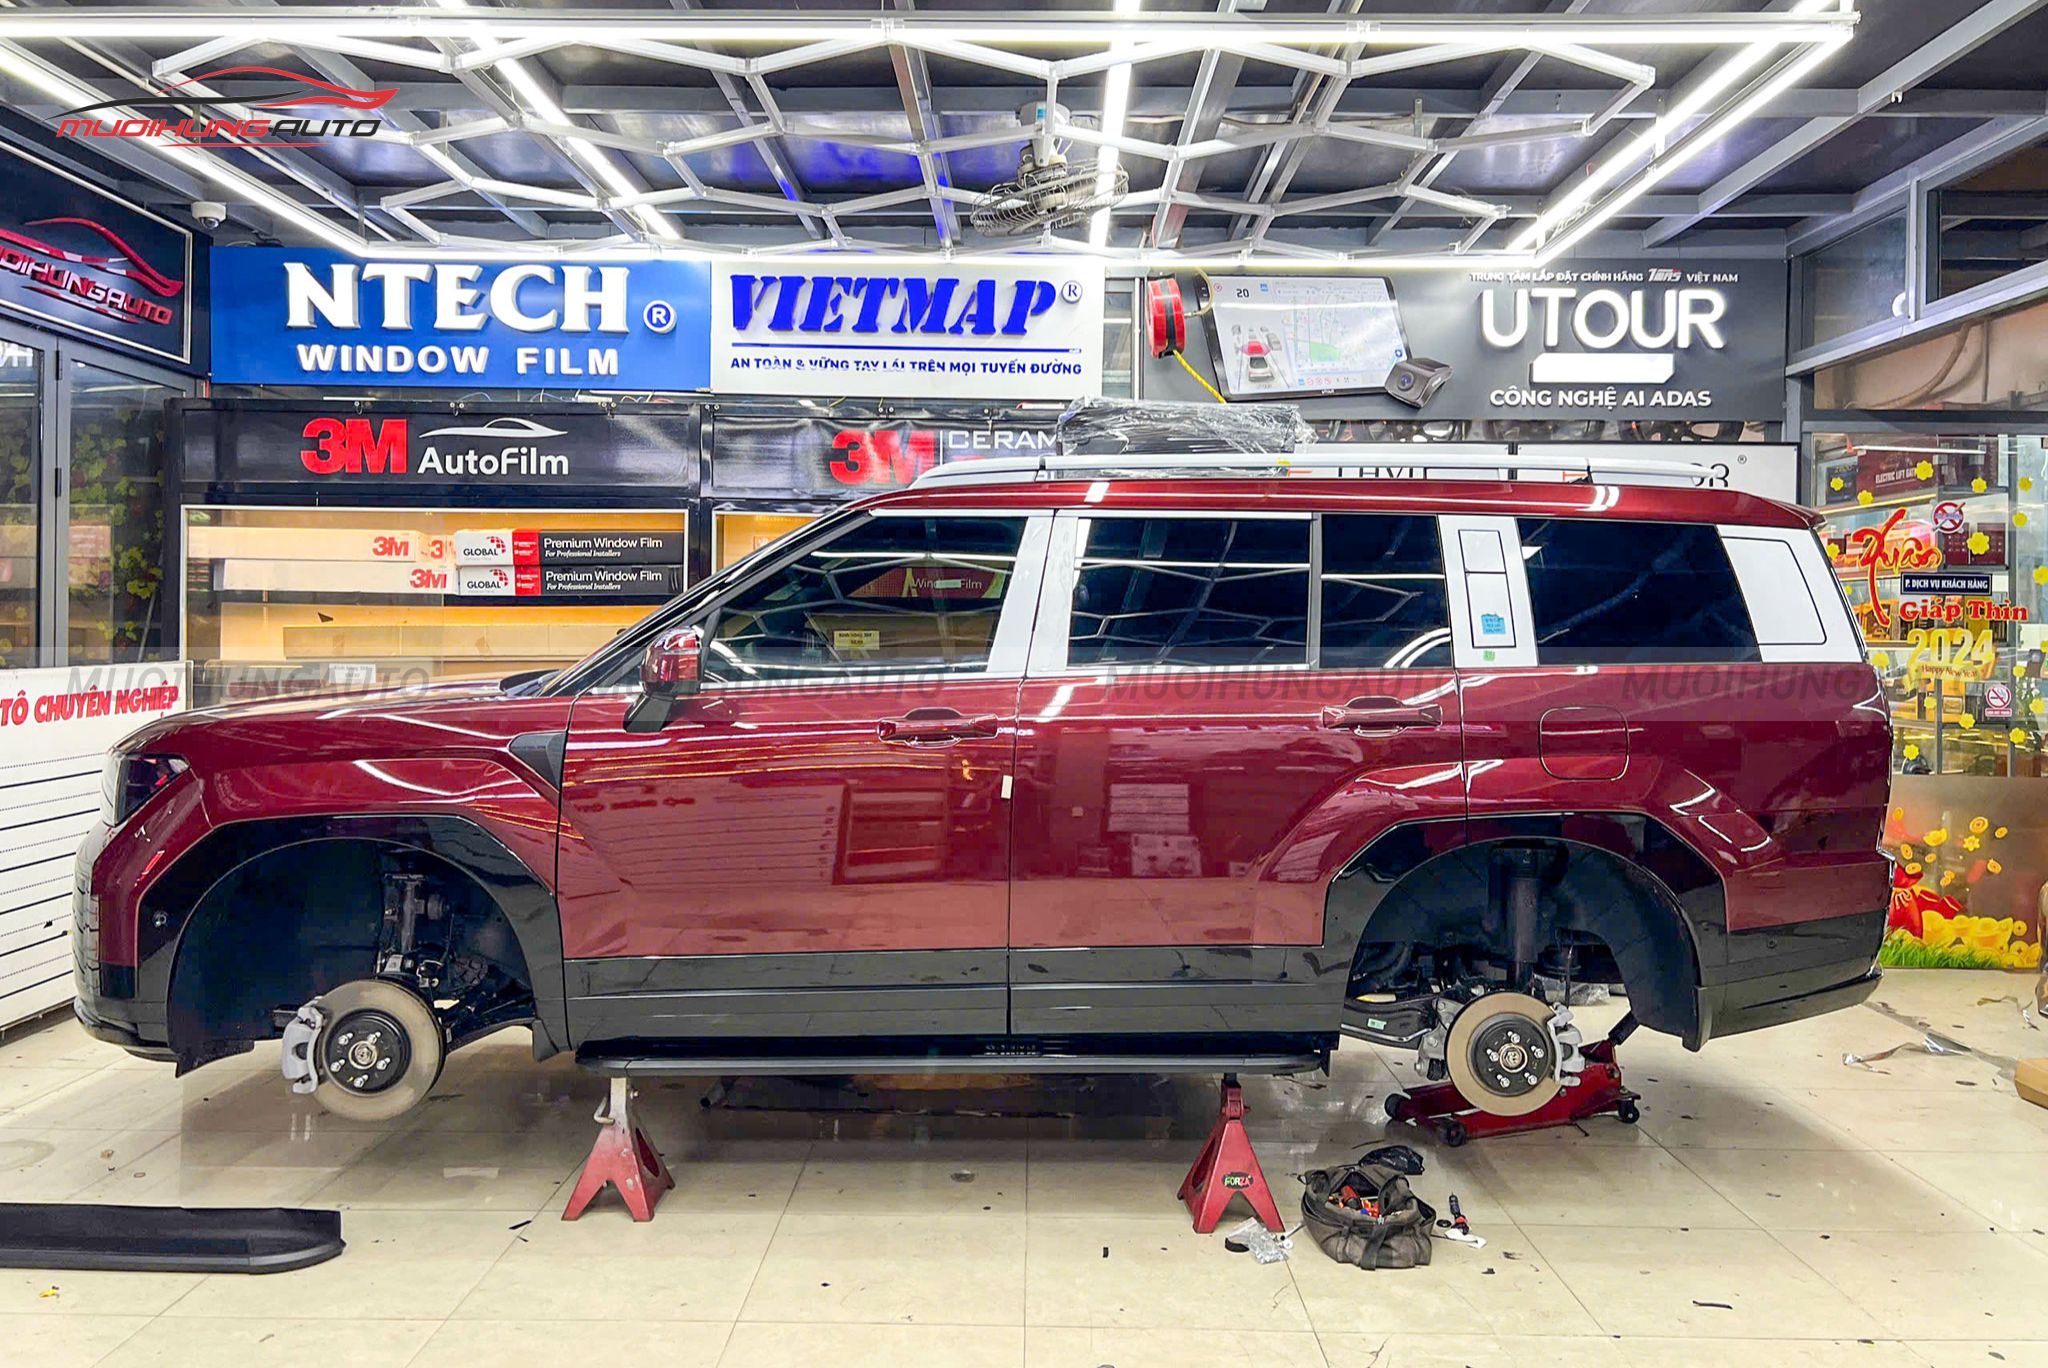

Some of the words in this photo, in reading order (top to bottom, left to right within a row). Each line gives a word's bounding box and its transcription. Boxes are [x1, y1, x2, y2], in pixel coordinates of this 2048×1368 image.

[1470, 271, 1504, 283] TRUNG
[1506, 269, 1531, 283] TÂM
[1556, 270, 1579, 284] ĐẶT
[1580, 270, 1611, 283] CHÍNH
[1613, 270, 1644, 282] HÃNG
[1686, 271, 1710, 284] VIỆT
[1712, 273, 1738, 282] NAM
[283, 262, 630, 334] NTECH
[730, 274, 1057, 335] VIETMAP
[1481, 288, 1726, 349] UTOUR
[297, 344, 490, 375] WINDOW
[516, 347, 619, 376] FILM
[731, 357, 750, 369] AN
[754, 355, 792, 369] TOÀN
[809, 356, 850, 370] VỮNG
[853, 359, 879, 372] TAY
[909, 358, 946, 373] TRÊN
[950, 361, 976, 376] MỌI
[980, 358, 1026, 374] TUYẾN
[1030, 358, 1082, 375] ĐƯỜNG
[1490, 386, 1552, 407] CÔNG
[1557, 386, 1618, 410] NGHỆ
[1622, 390, 1645, 406] AI
[1649, 390, 1712, 407] ADAS
[300, 417, 408, 474] 3M
[417, 446, 570, 476] AutoFilm
[829, 429, 936, 485] 3M
[372, 535, 409, 556] 3M
[463, 548, 499, 557] GLOBAL
[543, 538, 592, 550] Premium
[593, 537, 638, 549] Window
[639, 537, 663, 548] Film
[544, 550, 556, 558] For
[556, 549, 592, 558] Professional
[592, 549, 622, 557] Installers
[410, 568, 447, 589] 3M
[466, 580, 502, 589] GLOBAL
[545, 571, 593, 581] Premium
[594, 570, 638, 581] Window
[639, 570, 662, 581] Film
[1911, 578, 1929, 590] DỊCH
[1930, 578, 1940, 590] VỤ
[1941, 577, 1966, 588] KHÁCH
[1967, 578, 1988, 589] HÀNG
[546, 583, 557, 591] For
[557, 582, 593, 591] Professional
[593, 582, 621, 591] Installers
[1899, 598, 1963, 624] Giáp
[1906, 628, 1994, 667] 2024
[1921, 664, 1946, 677] Happy
[1945, 666, 1963, 677] New
[34, 684, 112, 724] CHUYÊN
[114, 680, 180, 719] NGHIỆP
[1224, 1175, 1250, 1187] FORZA
